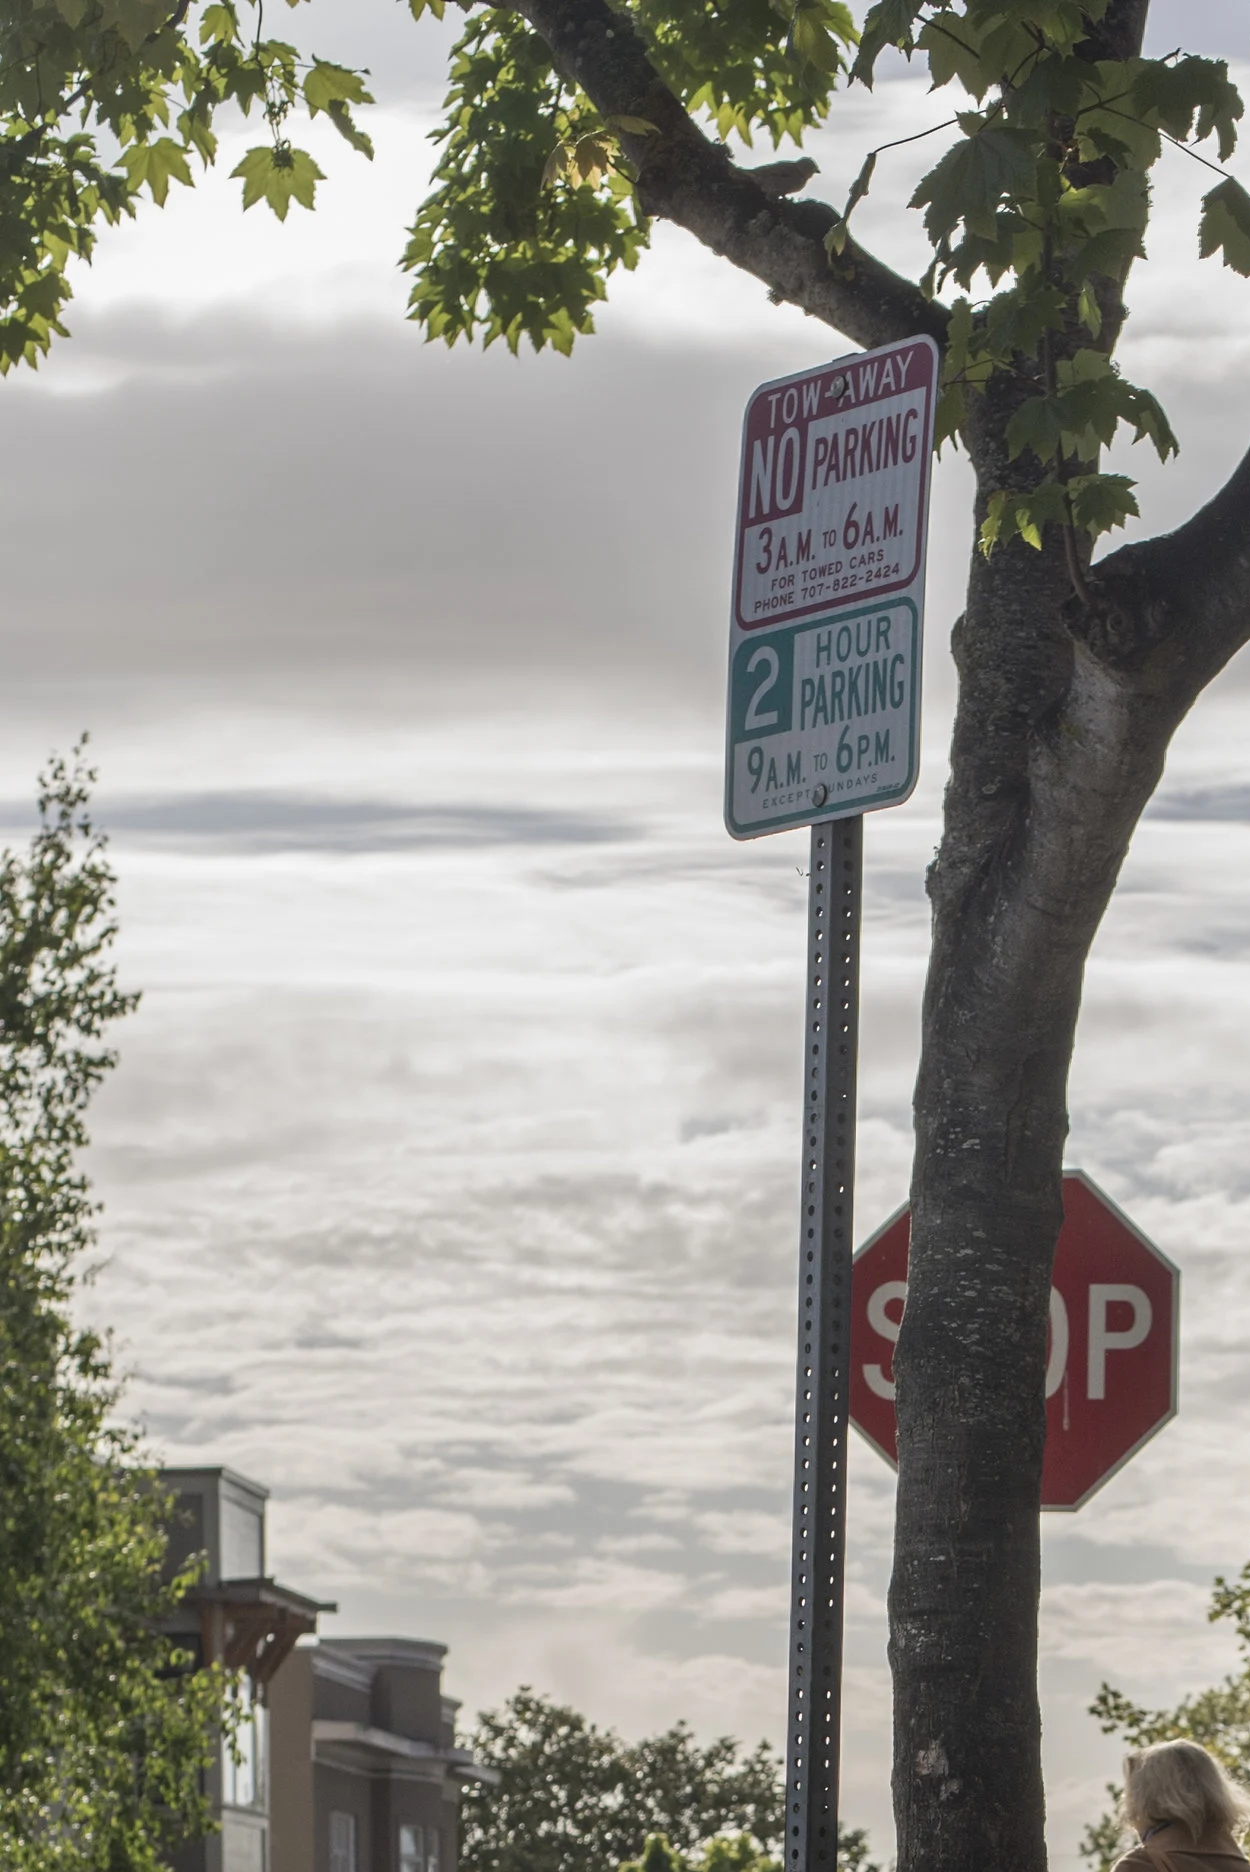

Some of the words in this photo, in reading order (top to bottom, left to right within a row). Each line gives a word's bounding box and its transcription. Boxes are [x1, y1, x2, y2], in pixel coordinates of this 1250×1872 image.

[768, 351, 914, 428] TOW-AWAY
[748, 426, 801, 519] NO
[811, 408, 918, 490] PARKING
[771, 574, 795, 591] FOR
[801, 560, 843, 583] TOWED
[849, 549, 885, 569] CARS
[822, 529, 837, 549] TO
[754, 592, 795, 613] PHONE
[801, 562, 900, 600] 707-822-2424
[744, 645, 780, 731] 2
[815, 615, 892, 668] HOUR
[800, 653, 905, 732] PARKING
[762, 788, 813, 809] EXCEPT
[820, 773, 879, 796] UNDAYS
[813, 752, 828, 772] TO
[862, 1280, 1154, 1401] SP
